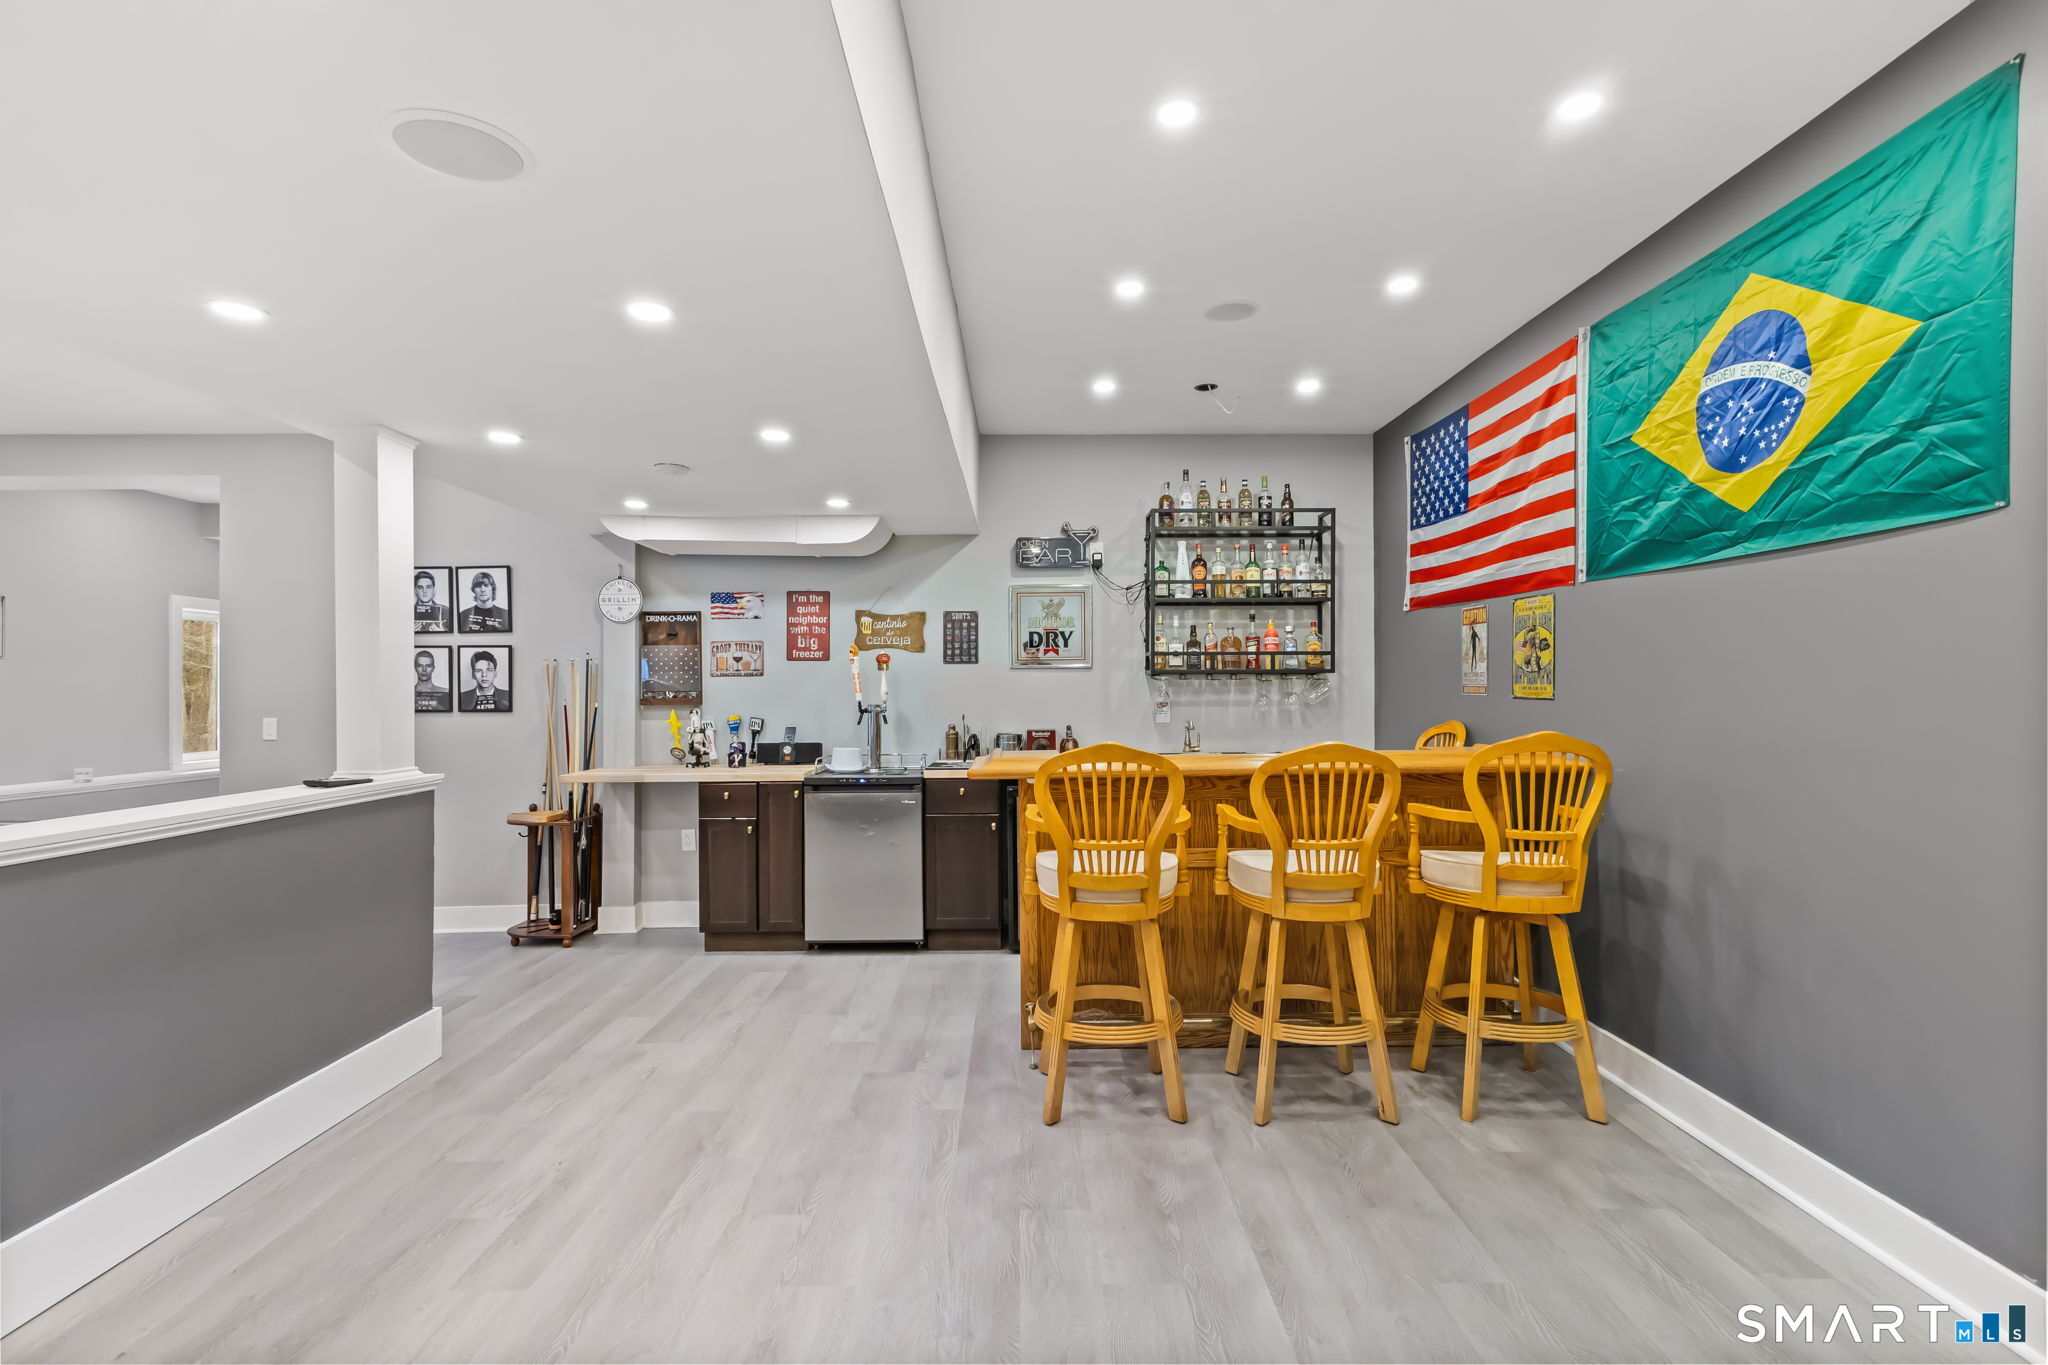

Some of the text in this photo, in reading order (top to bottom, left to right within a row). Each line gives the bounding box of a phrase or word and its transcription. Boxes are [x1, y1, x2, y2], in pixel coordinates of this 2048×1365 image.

[1704, 364, 1807, 387] ORDEM E PROGRESSO
[1020, 540, 1049, 549] OPEN
[1019, 548, 1072, 564] BAR
[792, 594, 823, 602] I'm the
[797, 605, 819, 613] quiet
[645, 614, 698, 622] DRINK-O-RAMA
[788, 615, 828, 624] neighbor
[873, 617, 908, 629] cantinho
[797, 635, 818, 650] big
[866, 635, 911, 646] cerveja
[1028, 631, 1074, 648] DRY
[711, 643, 732, 657] GROUP
[792, 649, 823, 658] freezer
[702, 722, 714, 730] IPA
